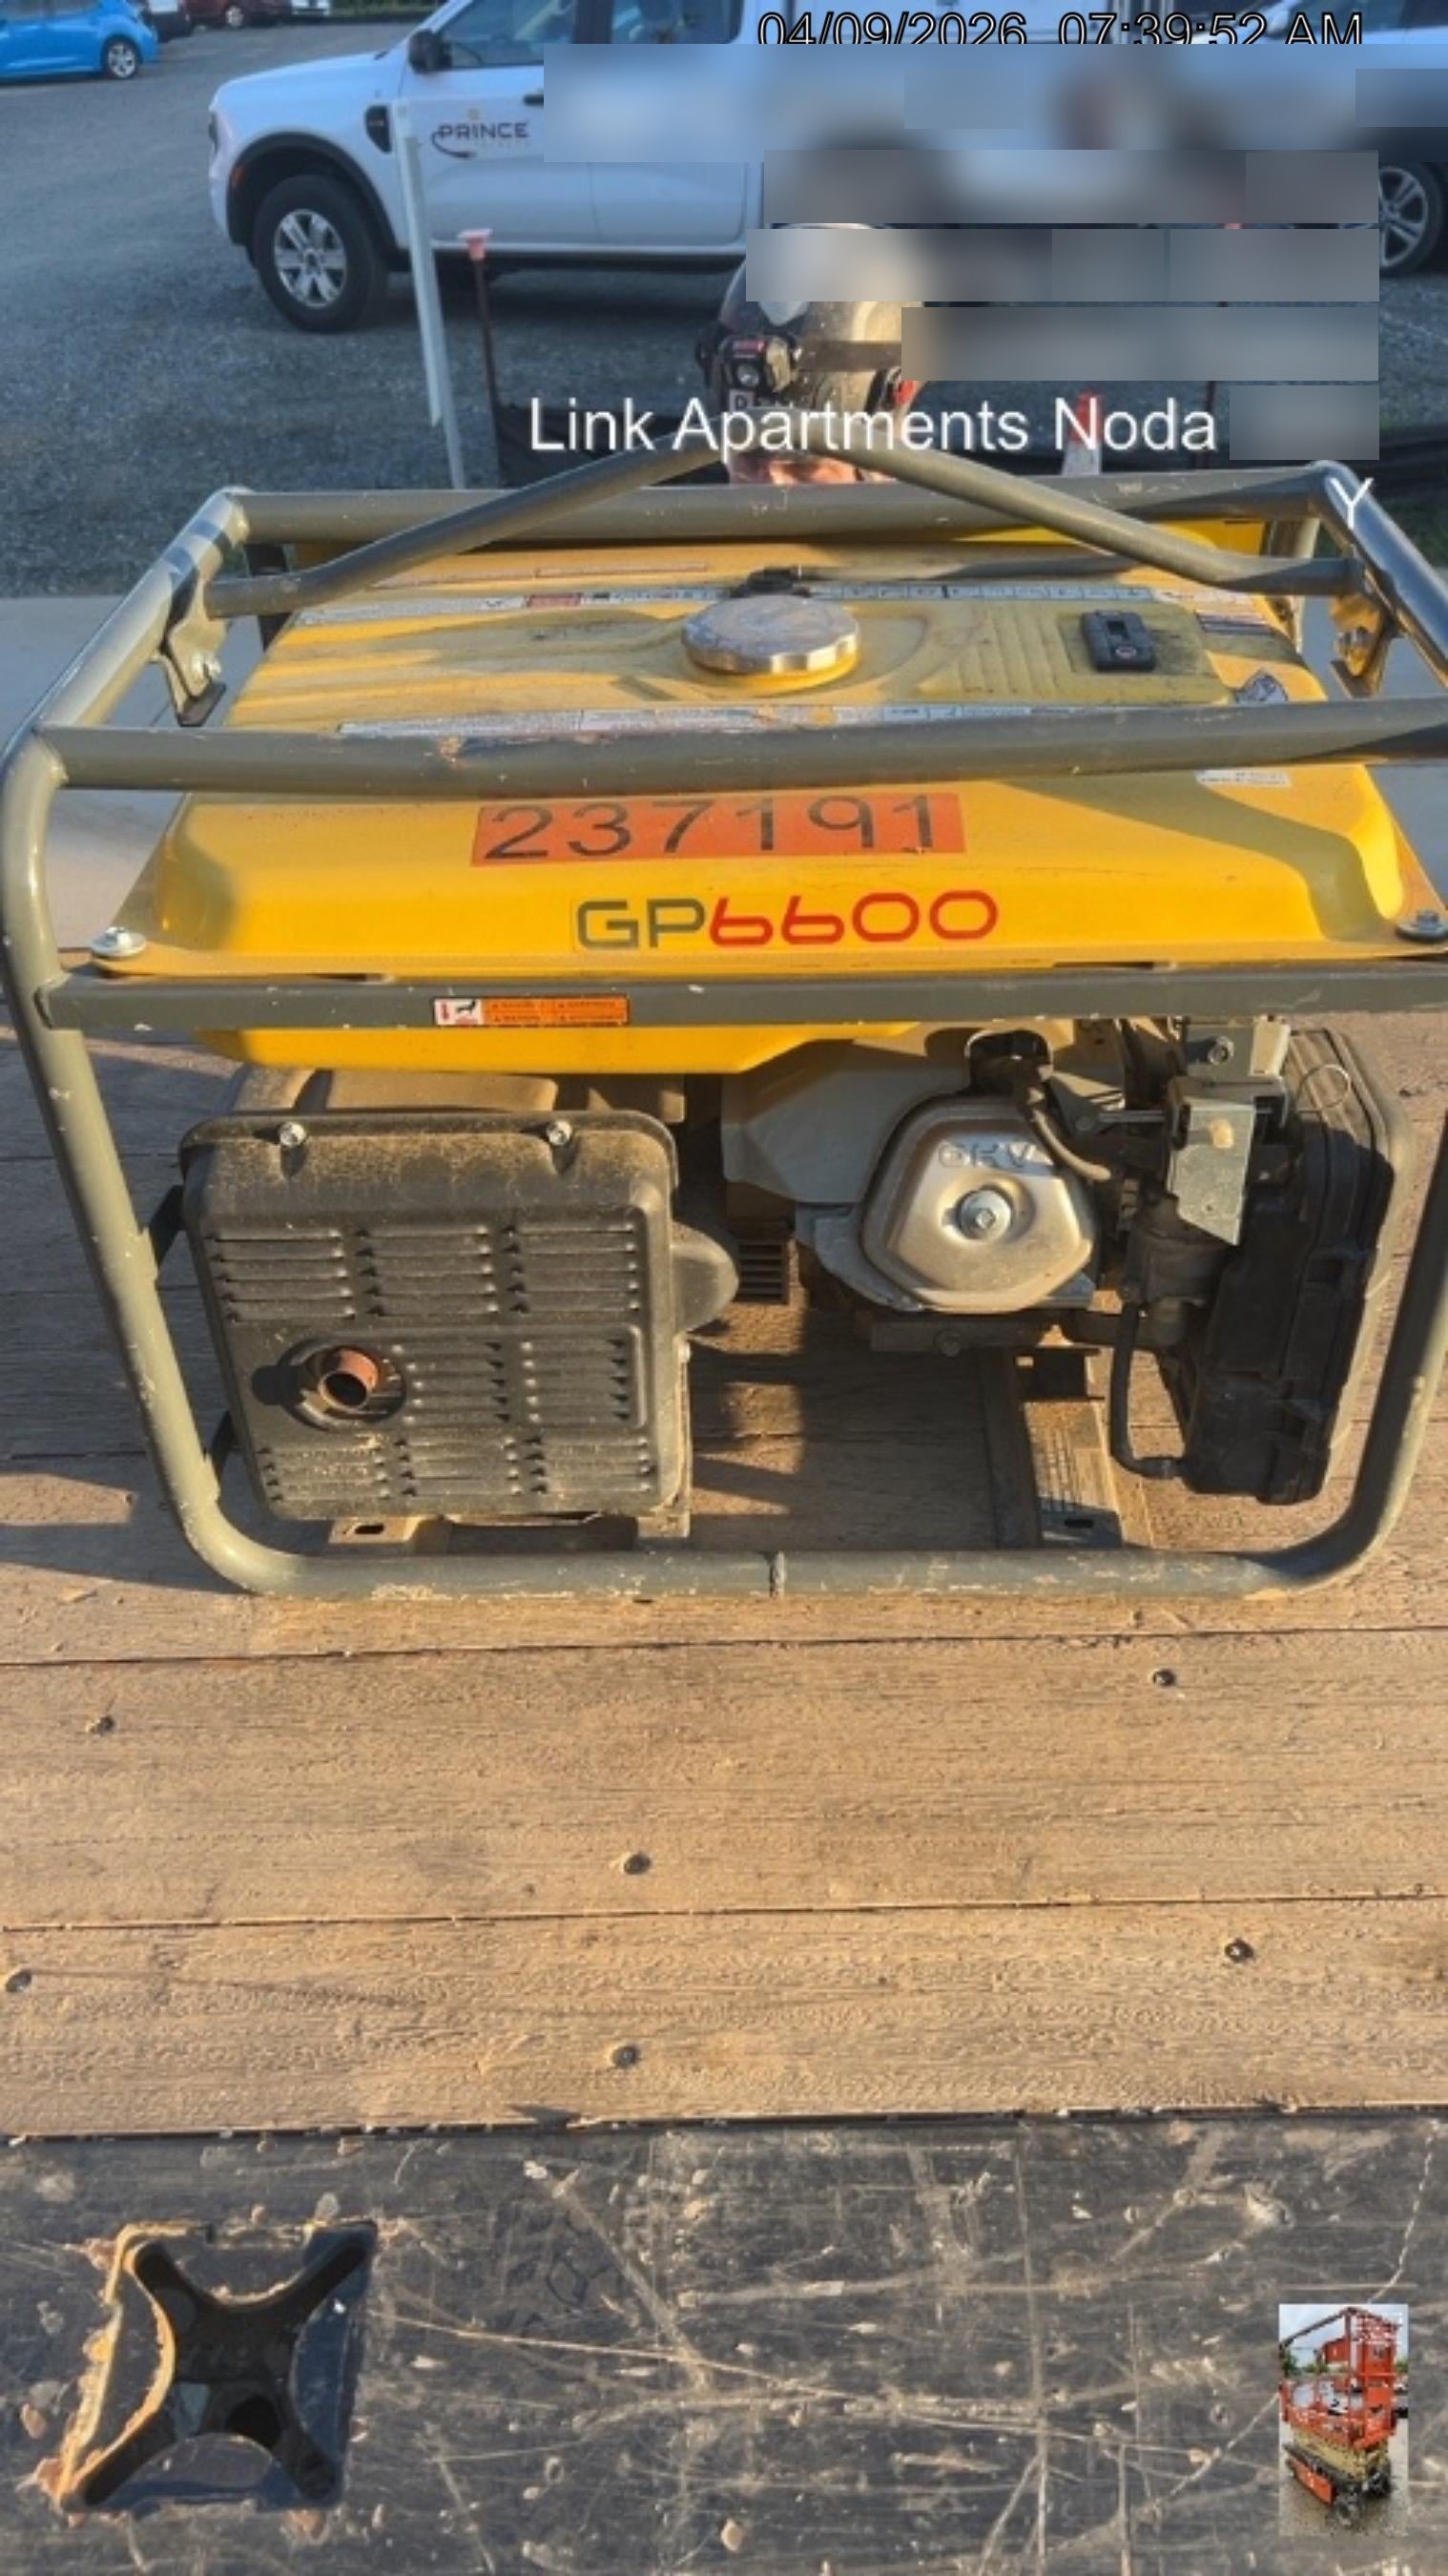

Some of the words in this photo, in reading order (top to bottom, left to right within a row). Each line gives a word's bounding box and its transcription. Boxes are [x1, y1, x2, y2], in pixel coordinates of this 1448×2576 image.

[438, 121, 529, 140] PRINCE
[484, 794, 934, 860] 237191
[577, 889, 1000, 950] GP6600
